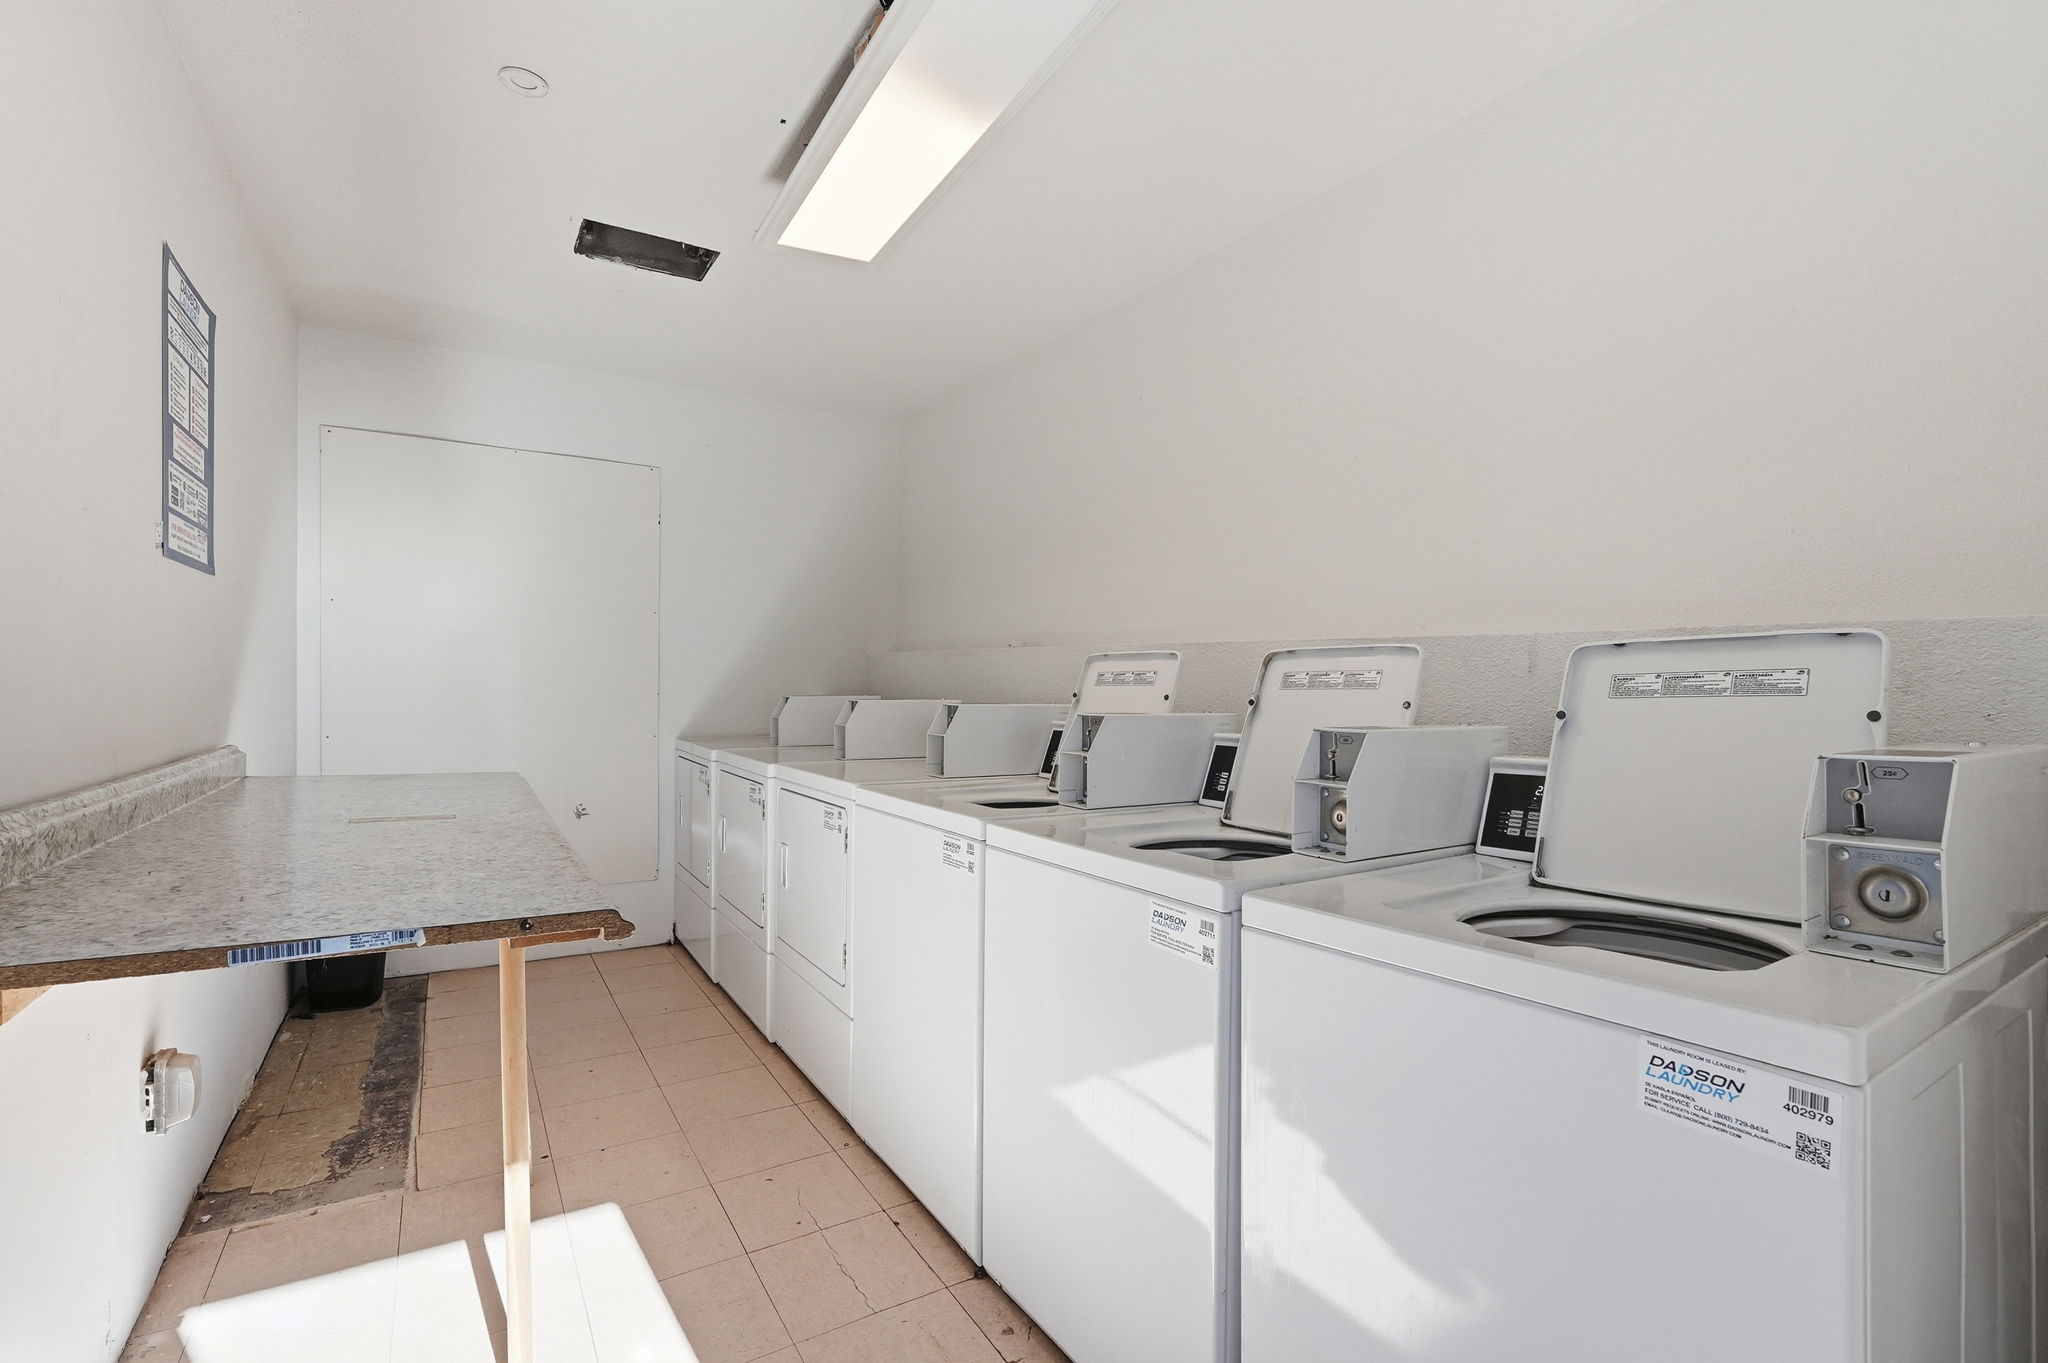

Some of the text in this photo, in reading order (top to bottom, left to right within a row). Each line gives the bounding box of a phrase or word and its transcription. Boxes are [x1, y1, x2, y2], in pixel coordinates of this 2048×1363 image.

[1855, 851, 1924, 866] GREENWALD
[1151, 916, 1185, 933] LAUNDRY
[1153, 910, 1187, 927] DADSON
[1659, 1044, 1685, 1055] LAUNDRY
[1686, 1052, 1704, 1061] ROOM
[1712, 1060, 1735, 1071] LEASED
[1645, 1066, 1740, 1103] LAUNDRY
[1649, 1055, 1745, 1093] DADSON
[1644, 1088, 1659, 1098] FOR
[1694, 1105, 1712, 1116] CALL
[1714, 1111, 1732, 1123] (800)
[1734, 1118, 1768, 1134] 729-8434
[1783, 1102, 1834, 1126] 402979
